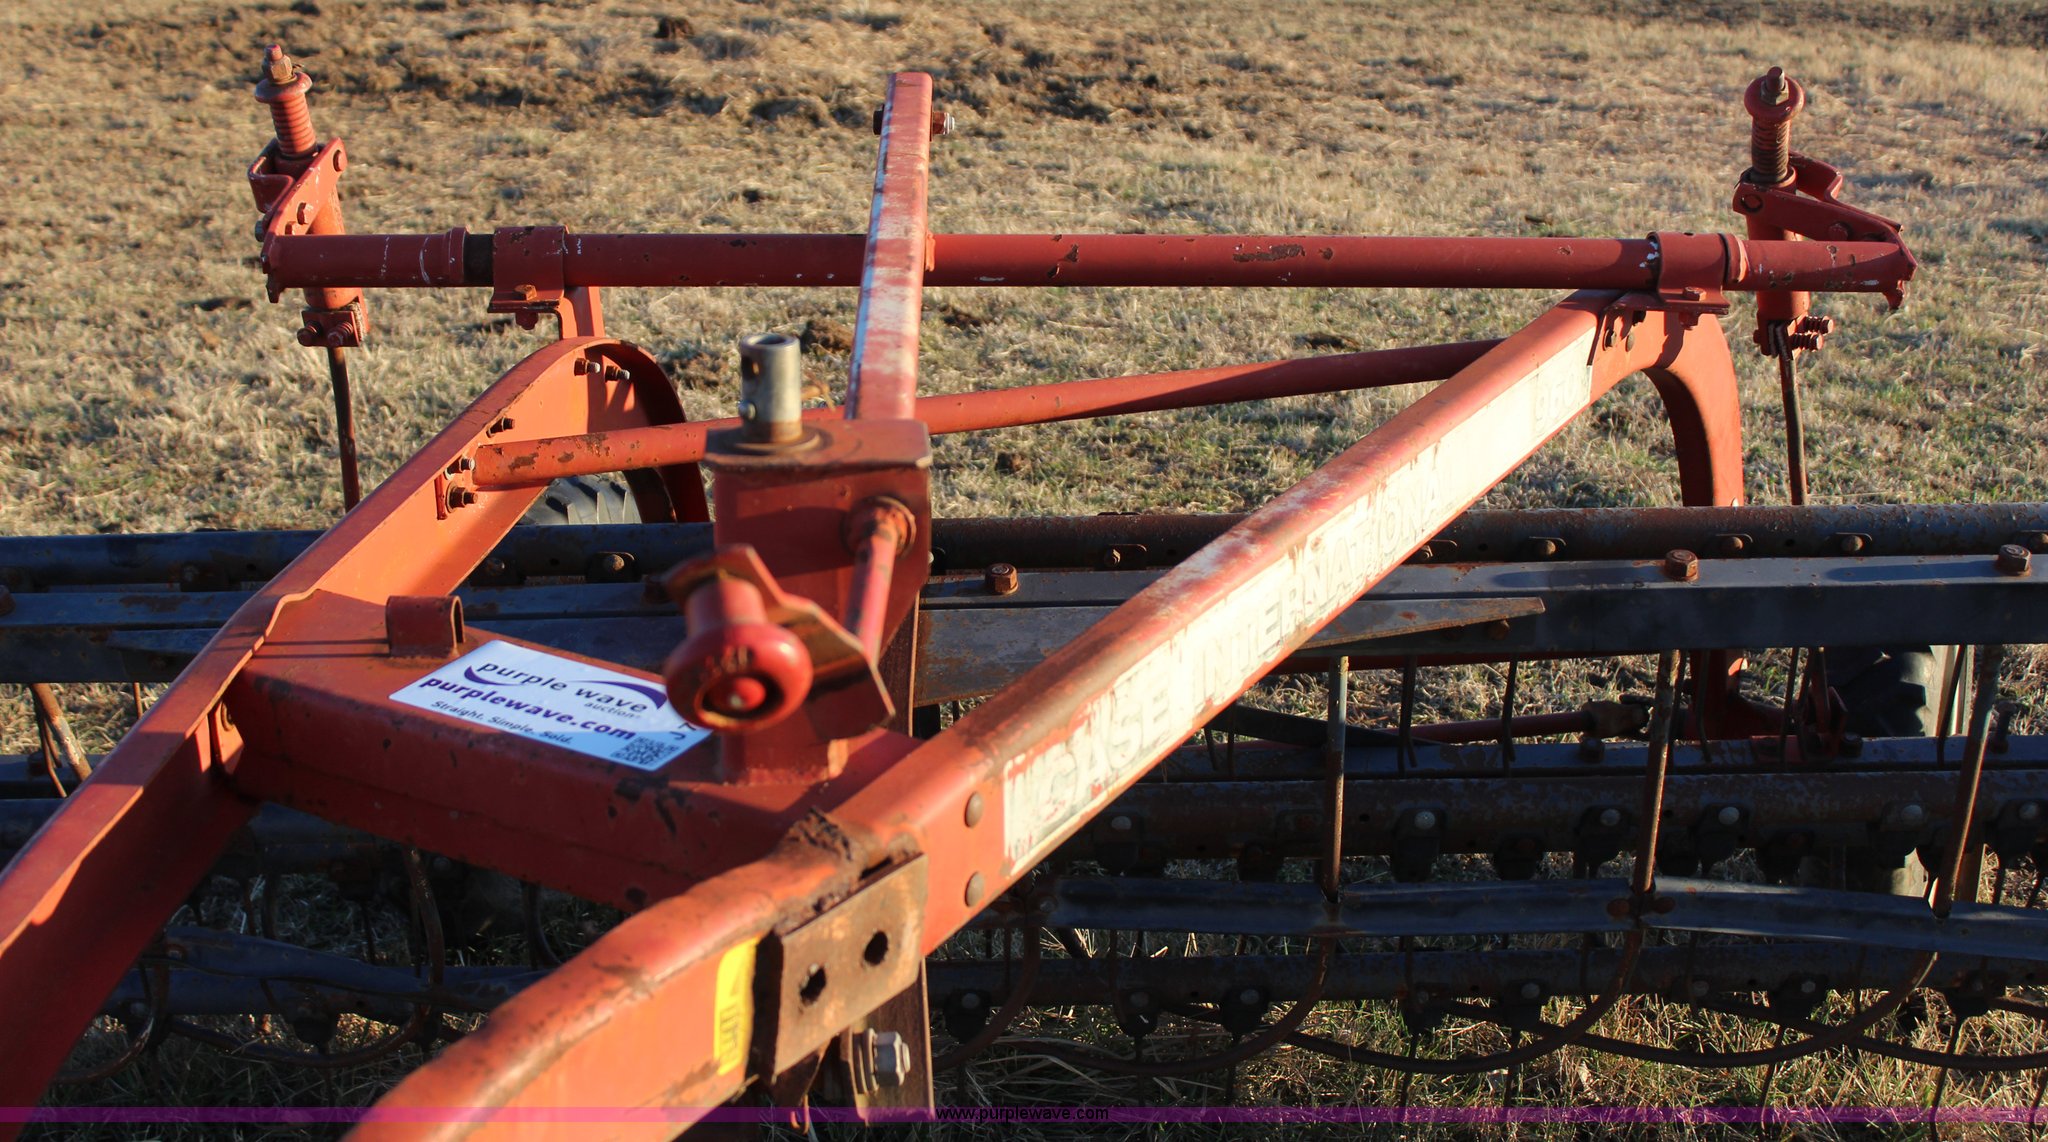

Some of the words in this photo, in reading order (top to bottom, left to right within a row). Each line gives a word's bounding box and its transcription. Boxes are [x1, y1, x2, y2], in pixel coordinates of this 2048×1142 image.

[1191, 452, 1456, 710] INTERNATIONA
[419, 678, 636, 740] purplewave.com
[476, 663, 567, 691] purple
[575, 688, 648, 712] wave
[584, 702, 636, 718] auction
[431, 701, 484, 720] Straight.
[488, 716, 534, 734] Simple.
[539, 731, 572, 744] Sold.
